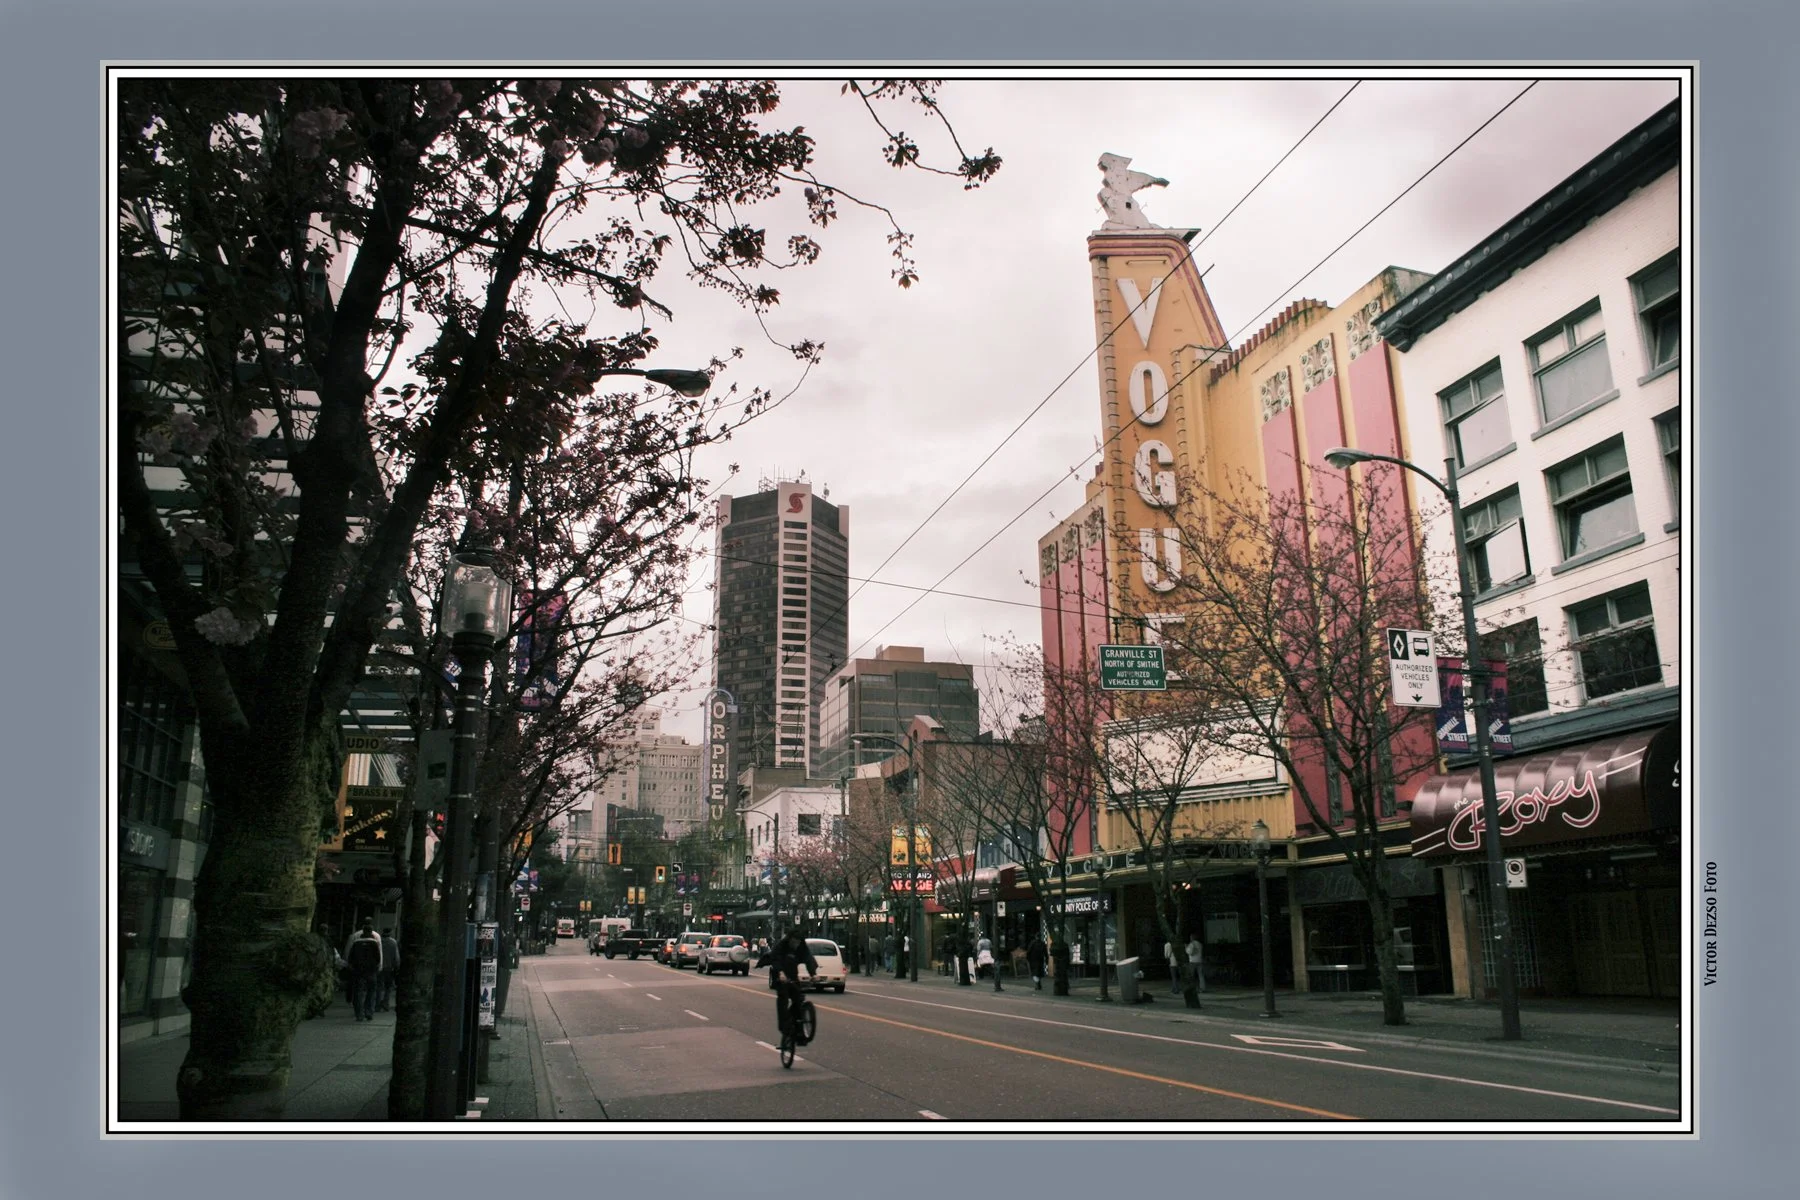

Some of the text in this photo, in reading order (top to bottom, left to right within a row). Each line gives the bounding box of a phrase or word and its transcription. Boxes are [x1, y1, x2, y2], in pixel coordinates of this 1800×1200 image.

[1117, 277, 1187, 681] VOGUE
[1105, 649, 1157, 659] GRANVILLE ST
[1104, 660, 1160, 669] NORTH OF SMITHE
[1395, 664, 1433, 673] AUTHORIZED
[1400, 673, 1430, 681] VEHICLES
[1407, 681, 1423, 689] ONLY
[346, 738, 379, 749] UDIO
[710, 701, 726, 841] ORPHEUM
[1453, 797, 1469, 810] the
[1447, 770, 1600, 851] Roxy
[1046, 852, 1137, 879] VOGUE
[890, 880, 933, 891] ARCDE
